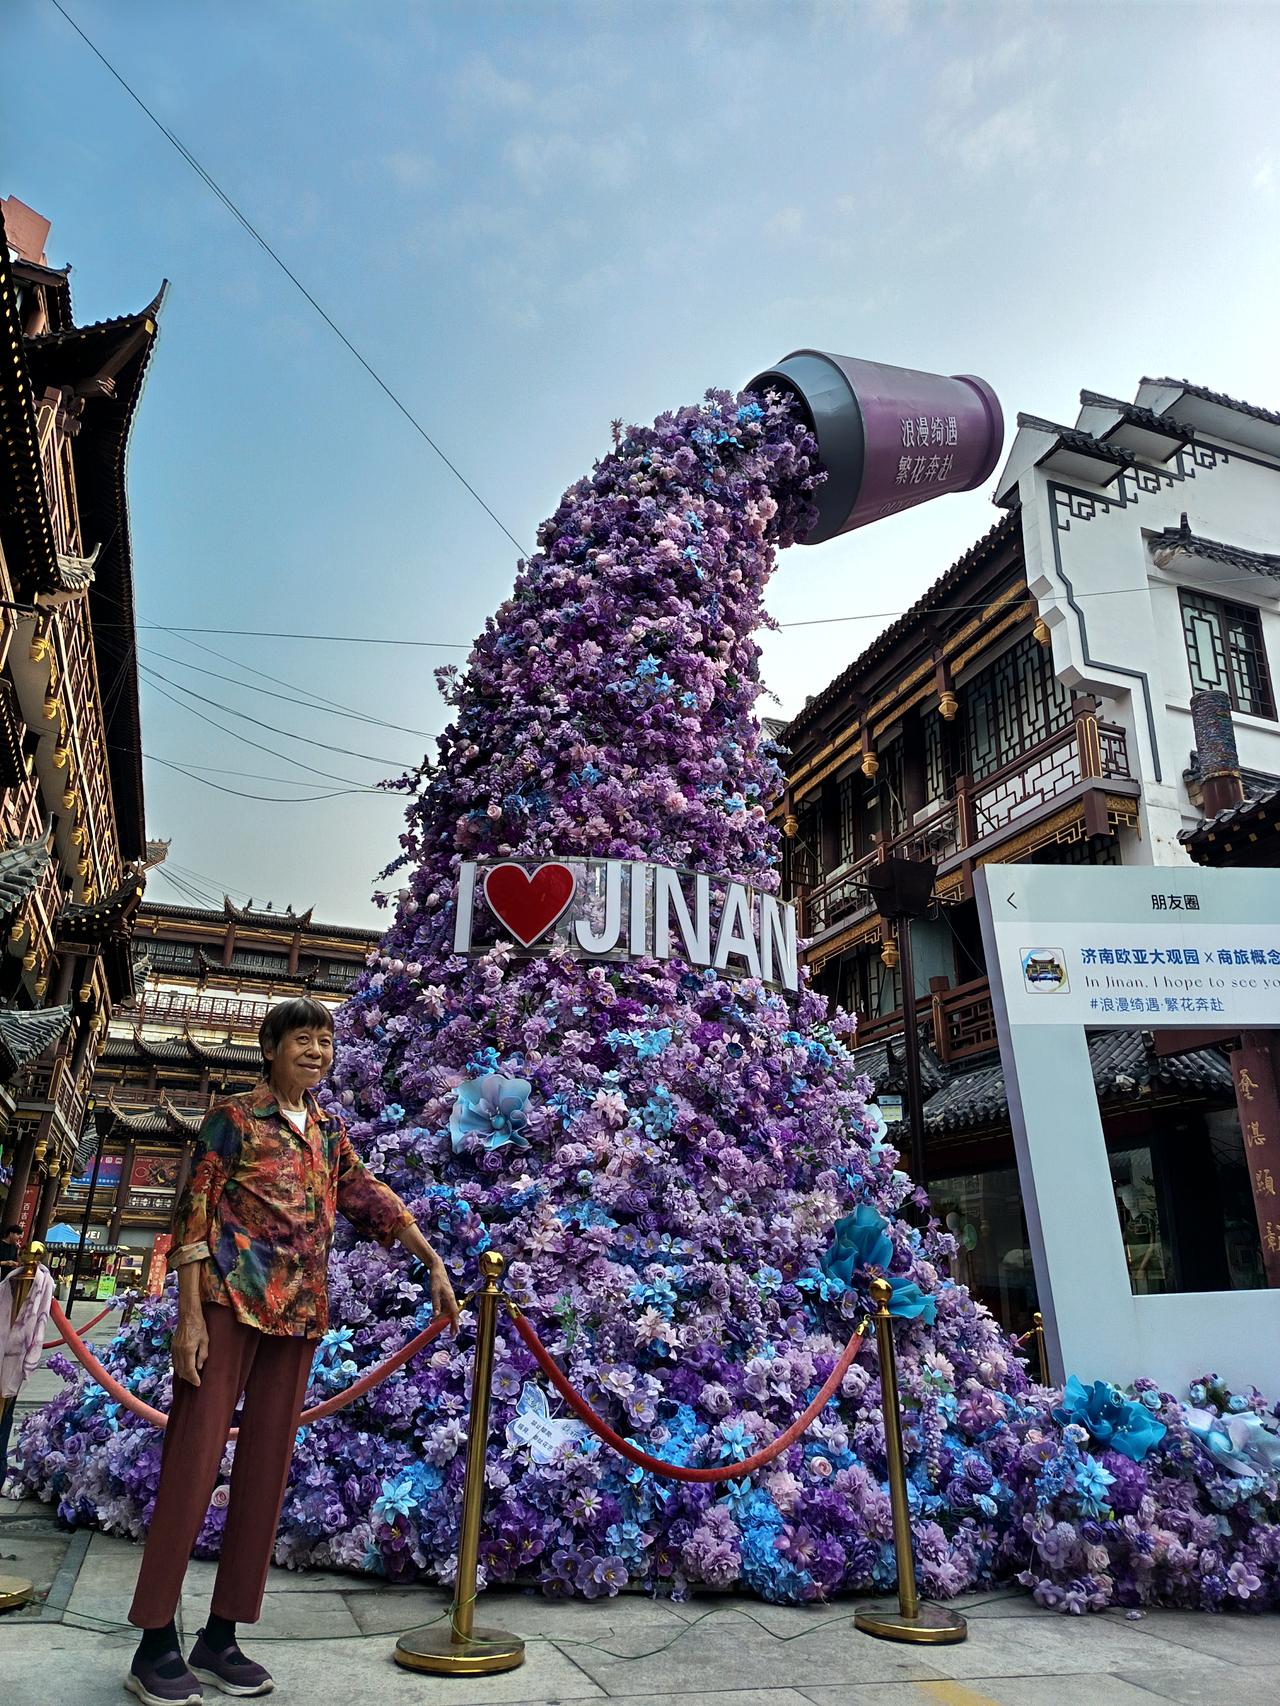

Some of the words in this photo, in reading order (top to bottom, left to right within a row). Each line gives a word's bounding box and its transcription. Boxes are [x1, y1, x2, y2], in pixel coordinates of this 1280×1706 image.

[901, 415, 958, 448] 浪漫绮遇
[895, 453, 954, 487] 繁花奔赴
[1151, 894, 1200, 911] 朋友圈
[453, 861, 478, 954] I
[574, 861, 799, 992] JINAN
[1085, 976, 1100, 988] In
[1153, 976, 1158, 988] I
[1164, 976, 1203, 991] hope
[1209, 977, 1225, 988] to
[1231, 979, 1257, 988] see
